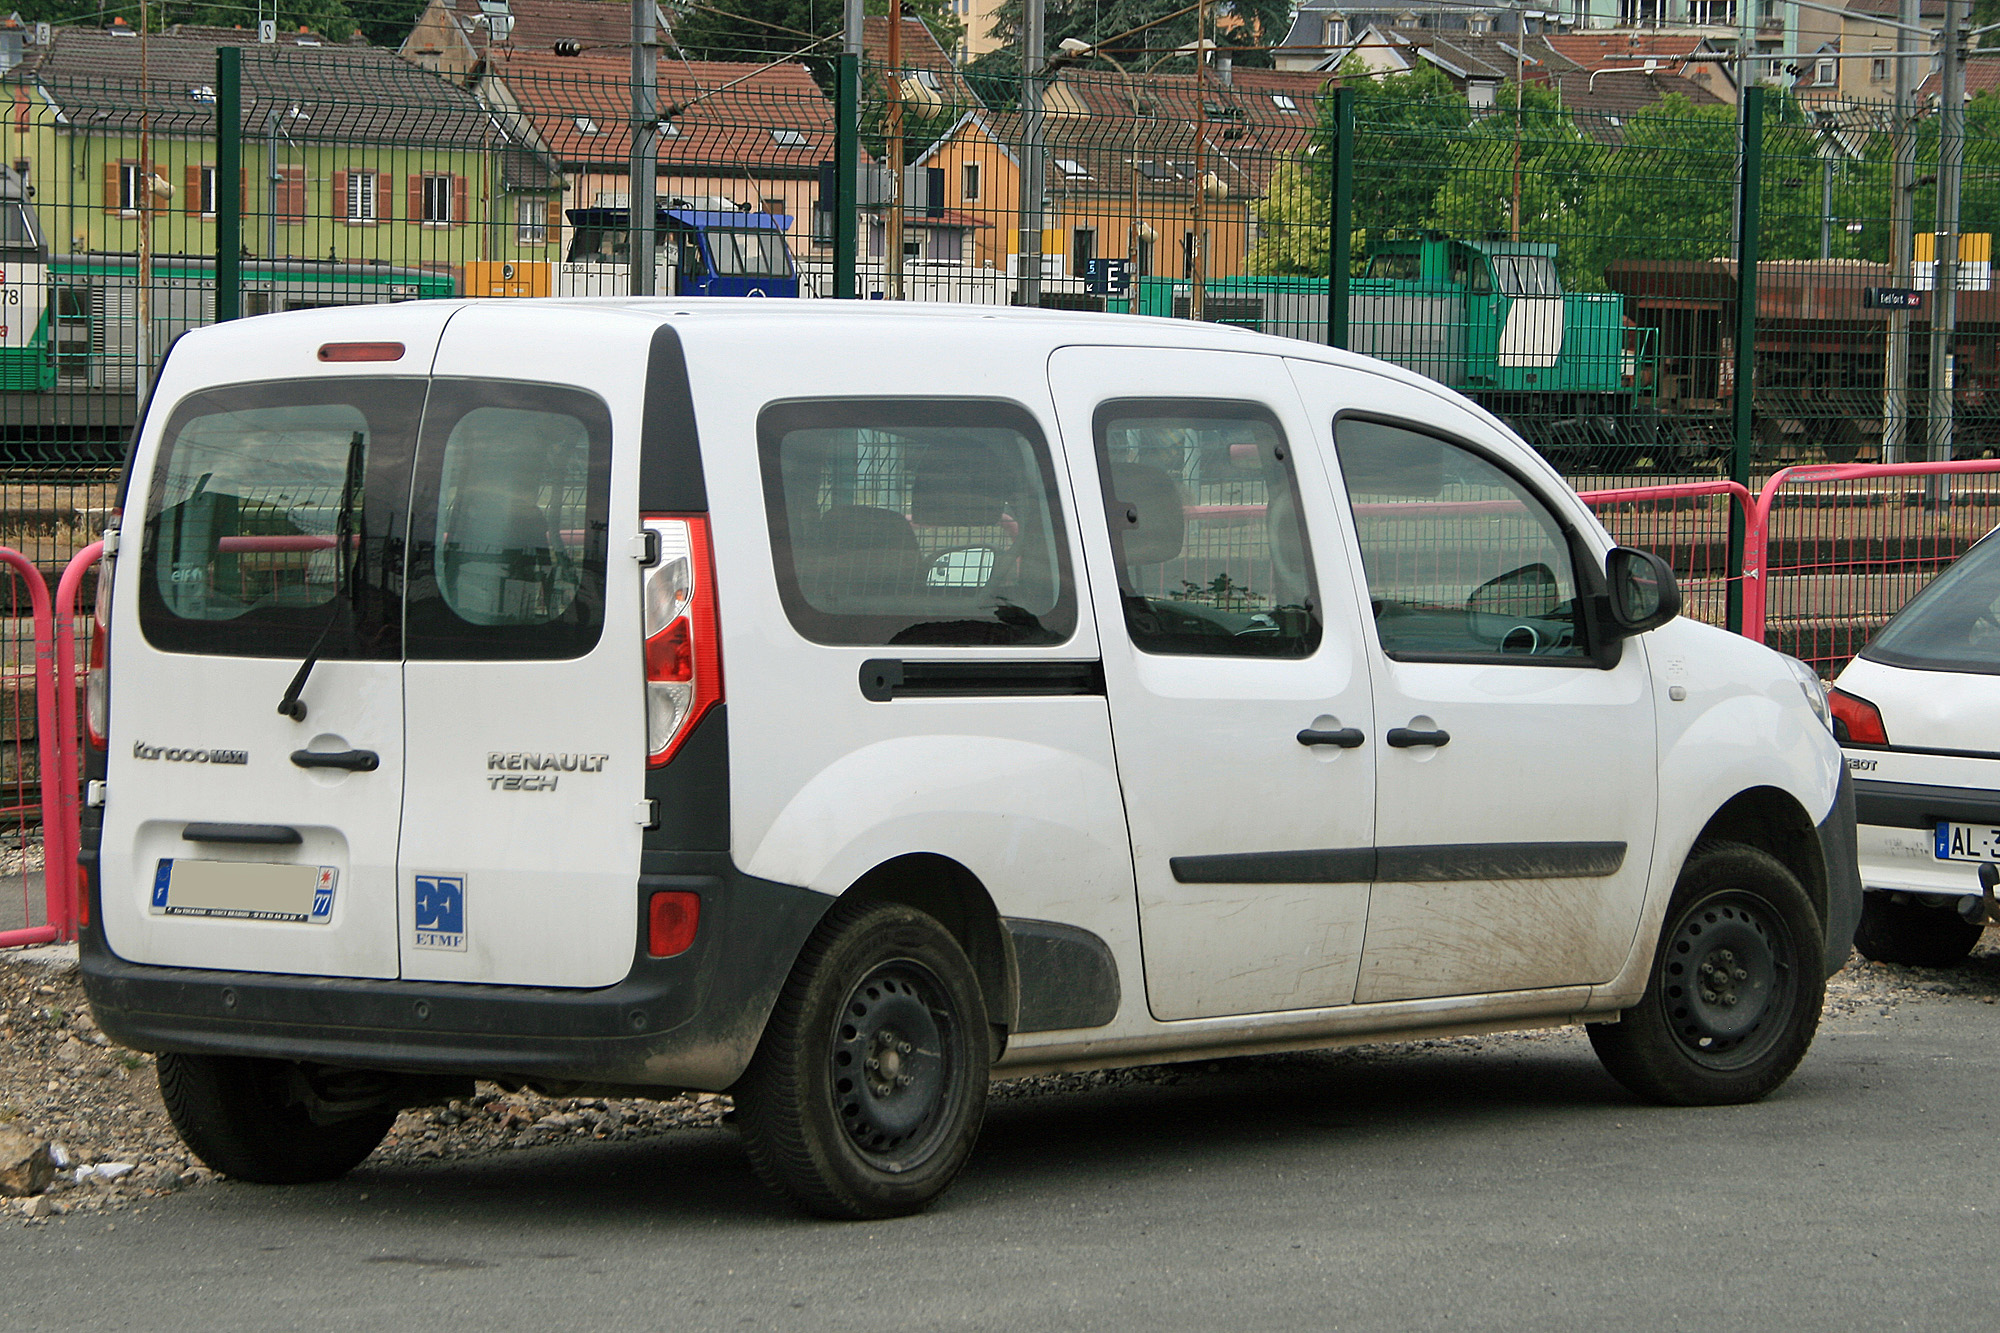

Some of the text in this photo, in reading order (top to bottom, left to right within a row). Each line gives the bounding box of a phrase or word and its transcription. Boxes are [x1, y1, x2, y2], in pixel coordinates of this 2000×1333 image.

[1107, 267, 1121, 292] E
[210, 749, 248, 765] MAXI
[486, 751, 609, 773] RENAULT
[487, 774, 559, 791] TECH
[156, 887, 164, 900] F
[313, 894, 331, 913] 77
[415, 932, 464, 948] ETMF
